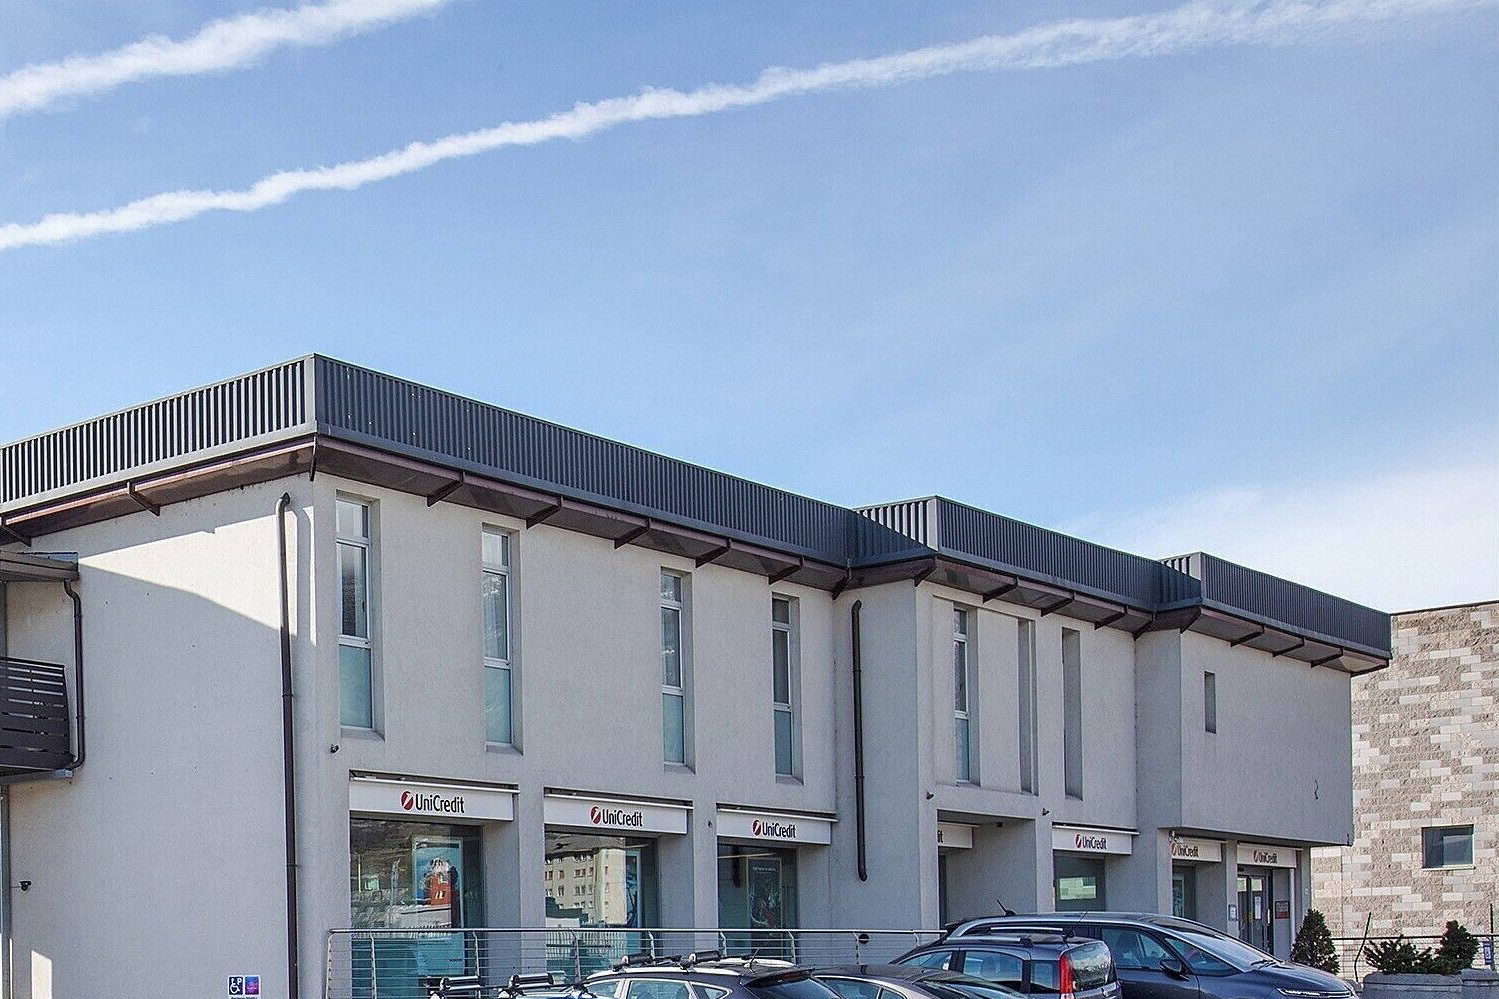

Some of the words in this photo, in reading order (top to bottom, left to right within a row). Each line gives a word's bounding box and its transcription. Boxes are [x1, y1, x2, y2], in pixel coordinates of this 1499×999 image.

[415, 794, 466, 814] UniCredit
[602, 809, 644, 827] UniCredit
[762, 822, 797, 839] UniCredit
[1082, 836, 1107, 850] UniCredit
